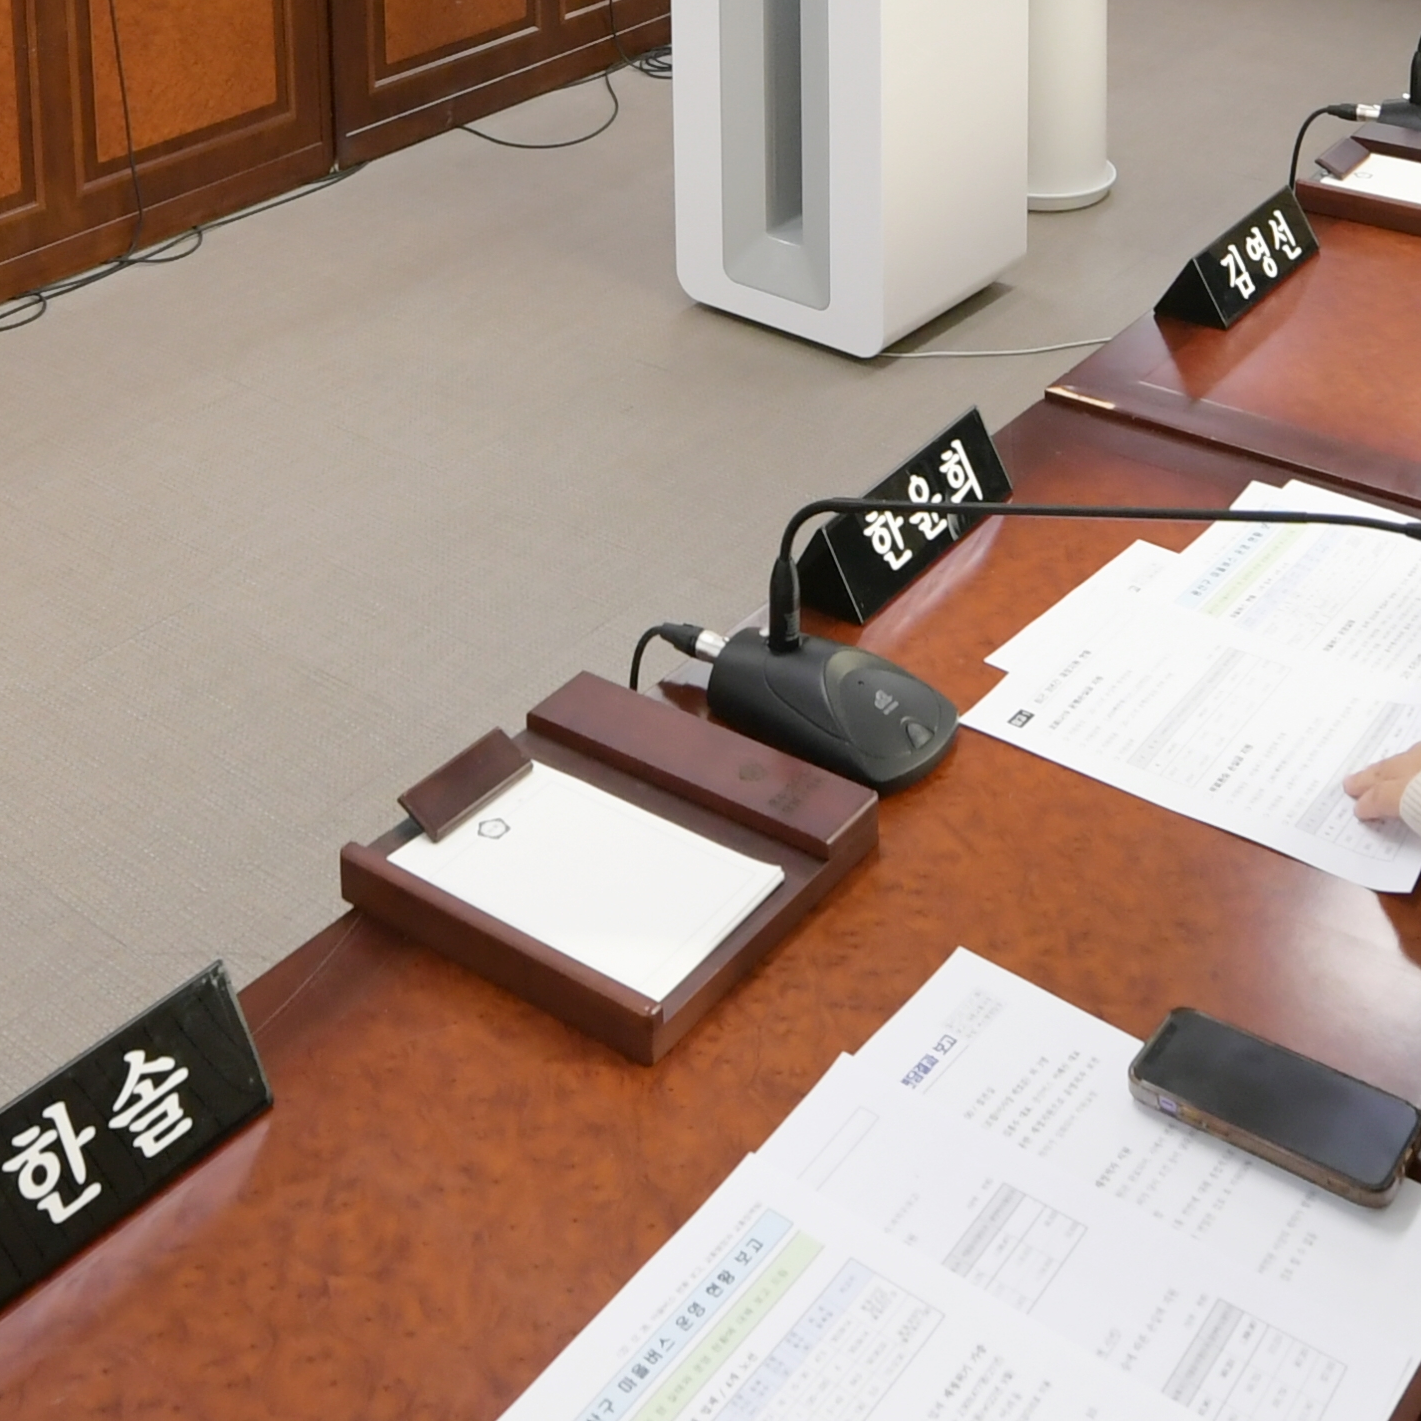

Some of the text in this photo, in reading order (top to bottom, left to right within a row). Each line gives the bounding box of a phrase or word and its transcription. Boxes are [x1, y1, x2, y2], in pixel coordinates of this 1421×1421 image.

[1220, 209, 1303, 299] 김영선
[863, 439, 983, 571] 한윤희
[618, 1339, 674, 1393] 마을버스
[676, 1302, 705, 1331] 운영
[706, 1270, 735, 1297] 현황
[734, 1238, 763, 1265] 보고
